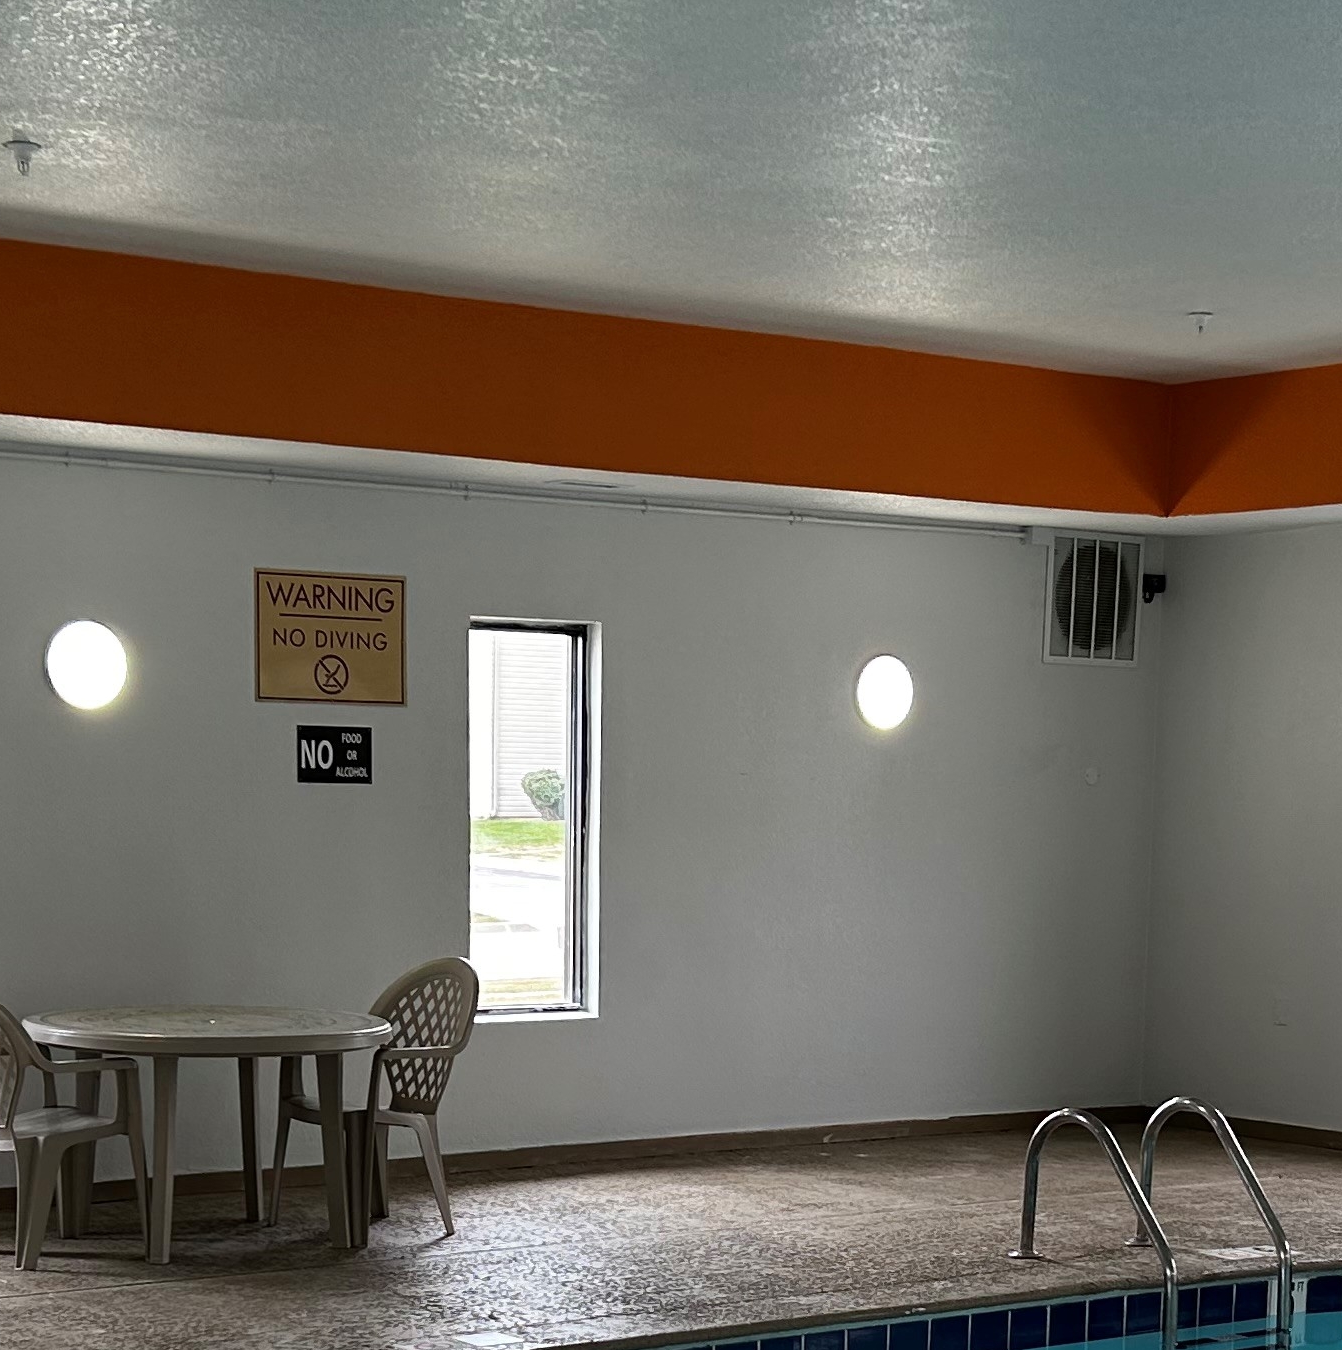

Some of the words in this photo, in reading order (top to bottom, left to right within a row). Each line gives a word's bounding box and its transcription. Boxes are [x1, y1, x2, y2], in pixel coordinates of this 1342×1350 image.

[266, 581, 395, 613] WARNING
[273, 627, 306, 647] NO
[315, 629, 388, 651] DIVING
[341, 732, 363, 744] FOOD
[300, 739, 334, 770] NO
[346, 749, 358, 761] OR
[335, 766, 369, 778] ALCOHOL
